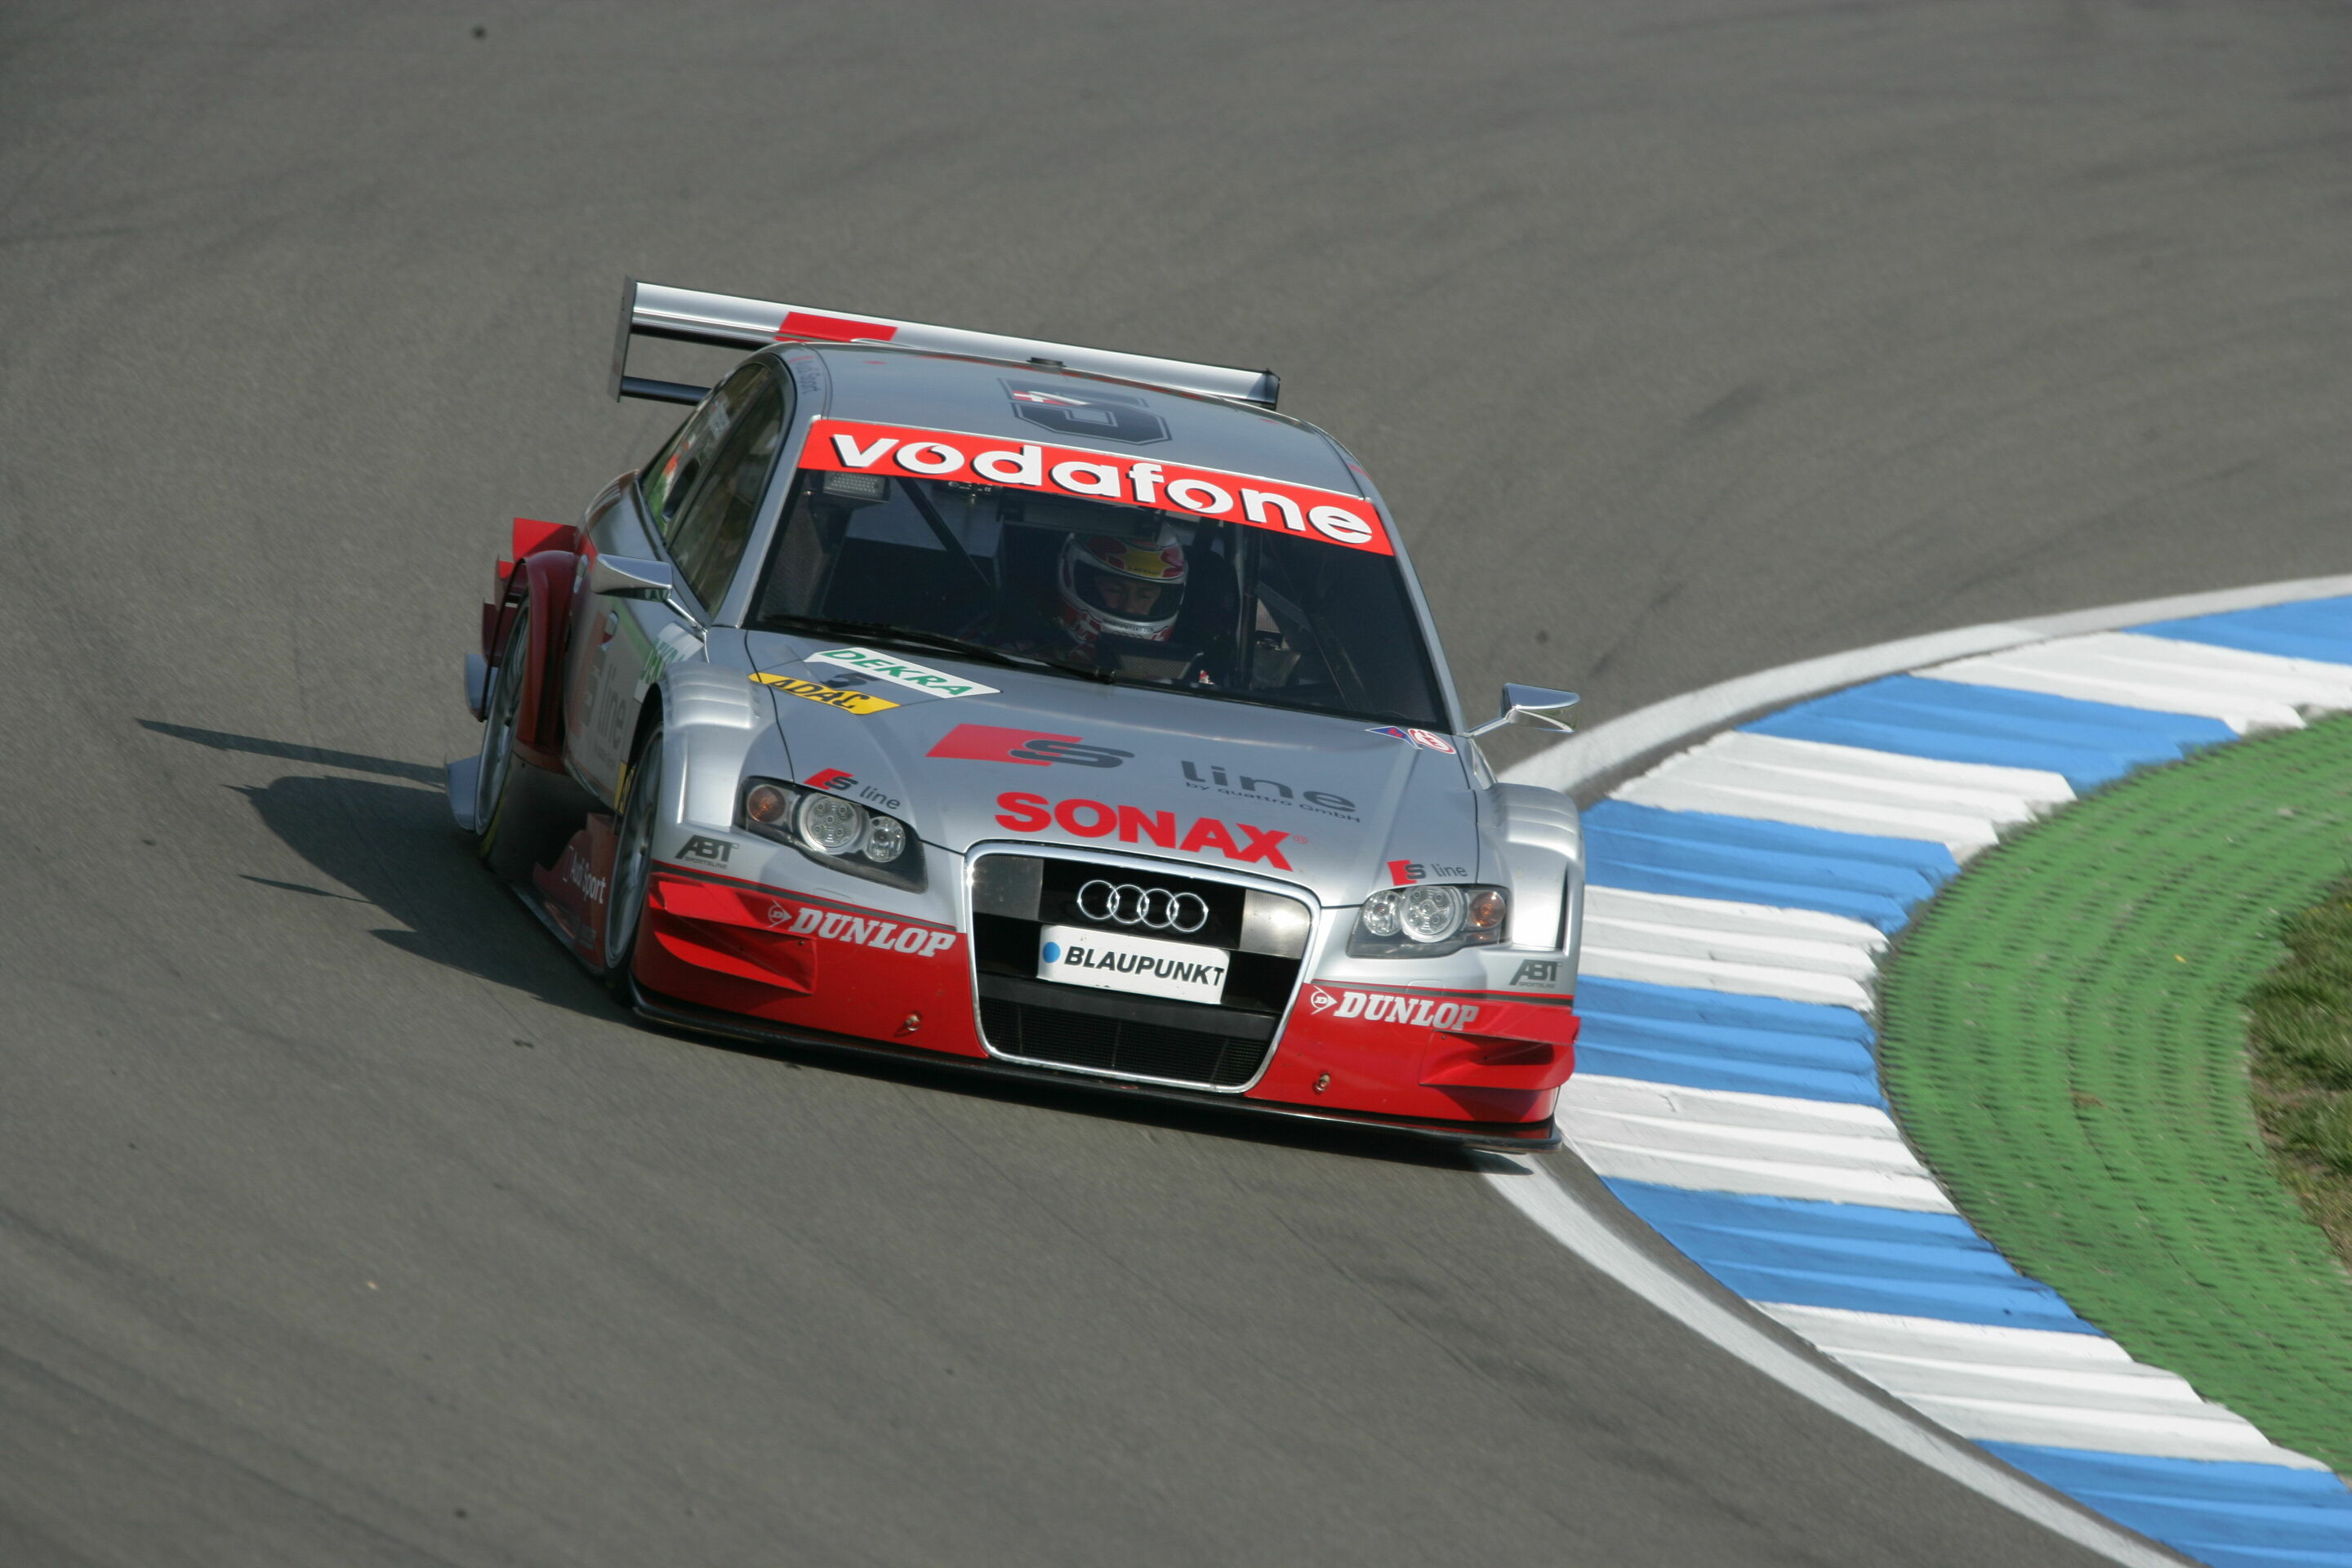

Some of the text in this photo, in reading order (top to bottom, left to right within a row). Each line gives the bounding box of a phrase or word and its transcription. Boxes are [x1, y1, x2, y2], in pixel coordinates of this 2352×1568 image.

[997, 378, 1173, 446] 5
[831, 434, 1373, 545] vodafone
[768, 678, 870, 709] ADAC
[818, 649, 975, 696] DEKRA
[824, 776, 901, 810] S line
[1009, 739, 1356, 812] S line
[1186, 781, 1361, 823] by quattro GmbH
[675, 835, 733, 859] ABT
[995, 791, 1294, 872] SONAX
[582, 862, 606, 905] Sport
[1405, 863, 1468, 880] S line
[788, 907, 957, 958] DUNLOP
[1064, 946, 1225, 987] BLAUPUNKT
[1508, 959, 1559, 986] ABT
[1333, 991, 1480, 1031] DUNLOP
